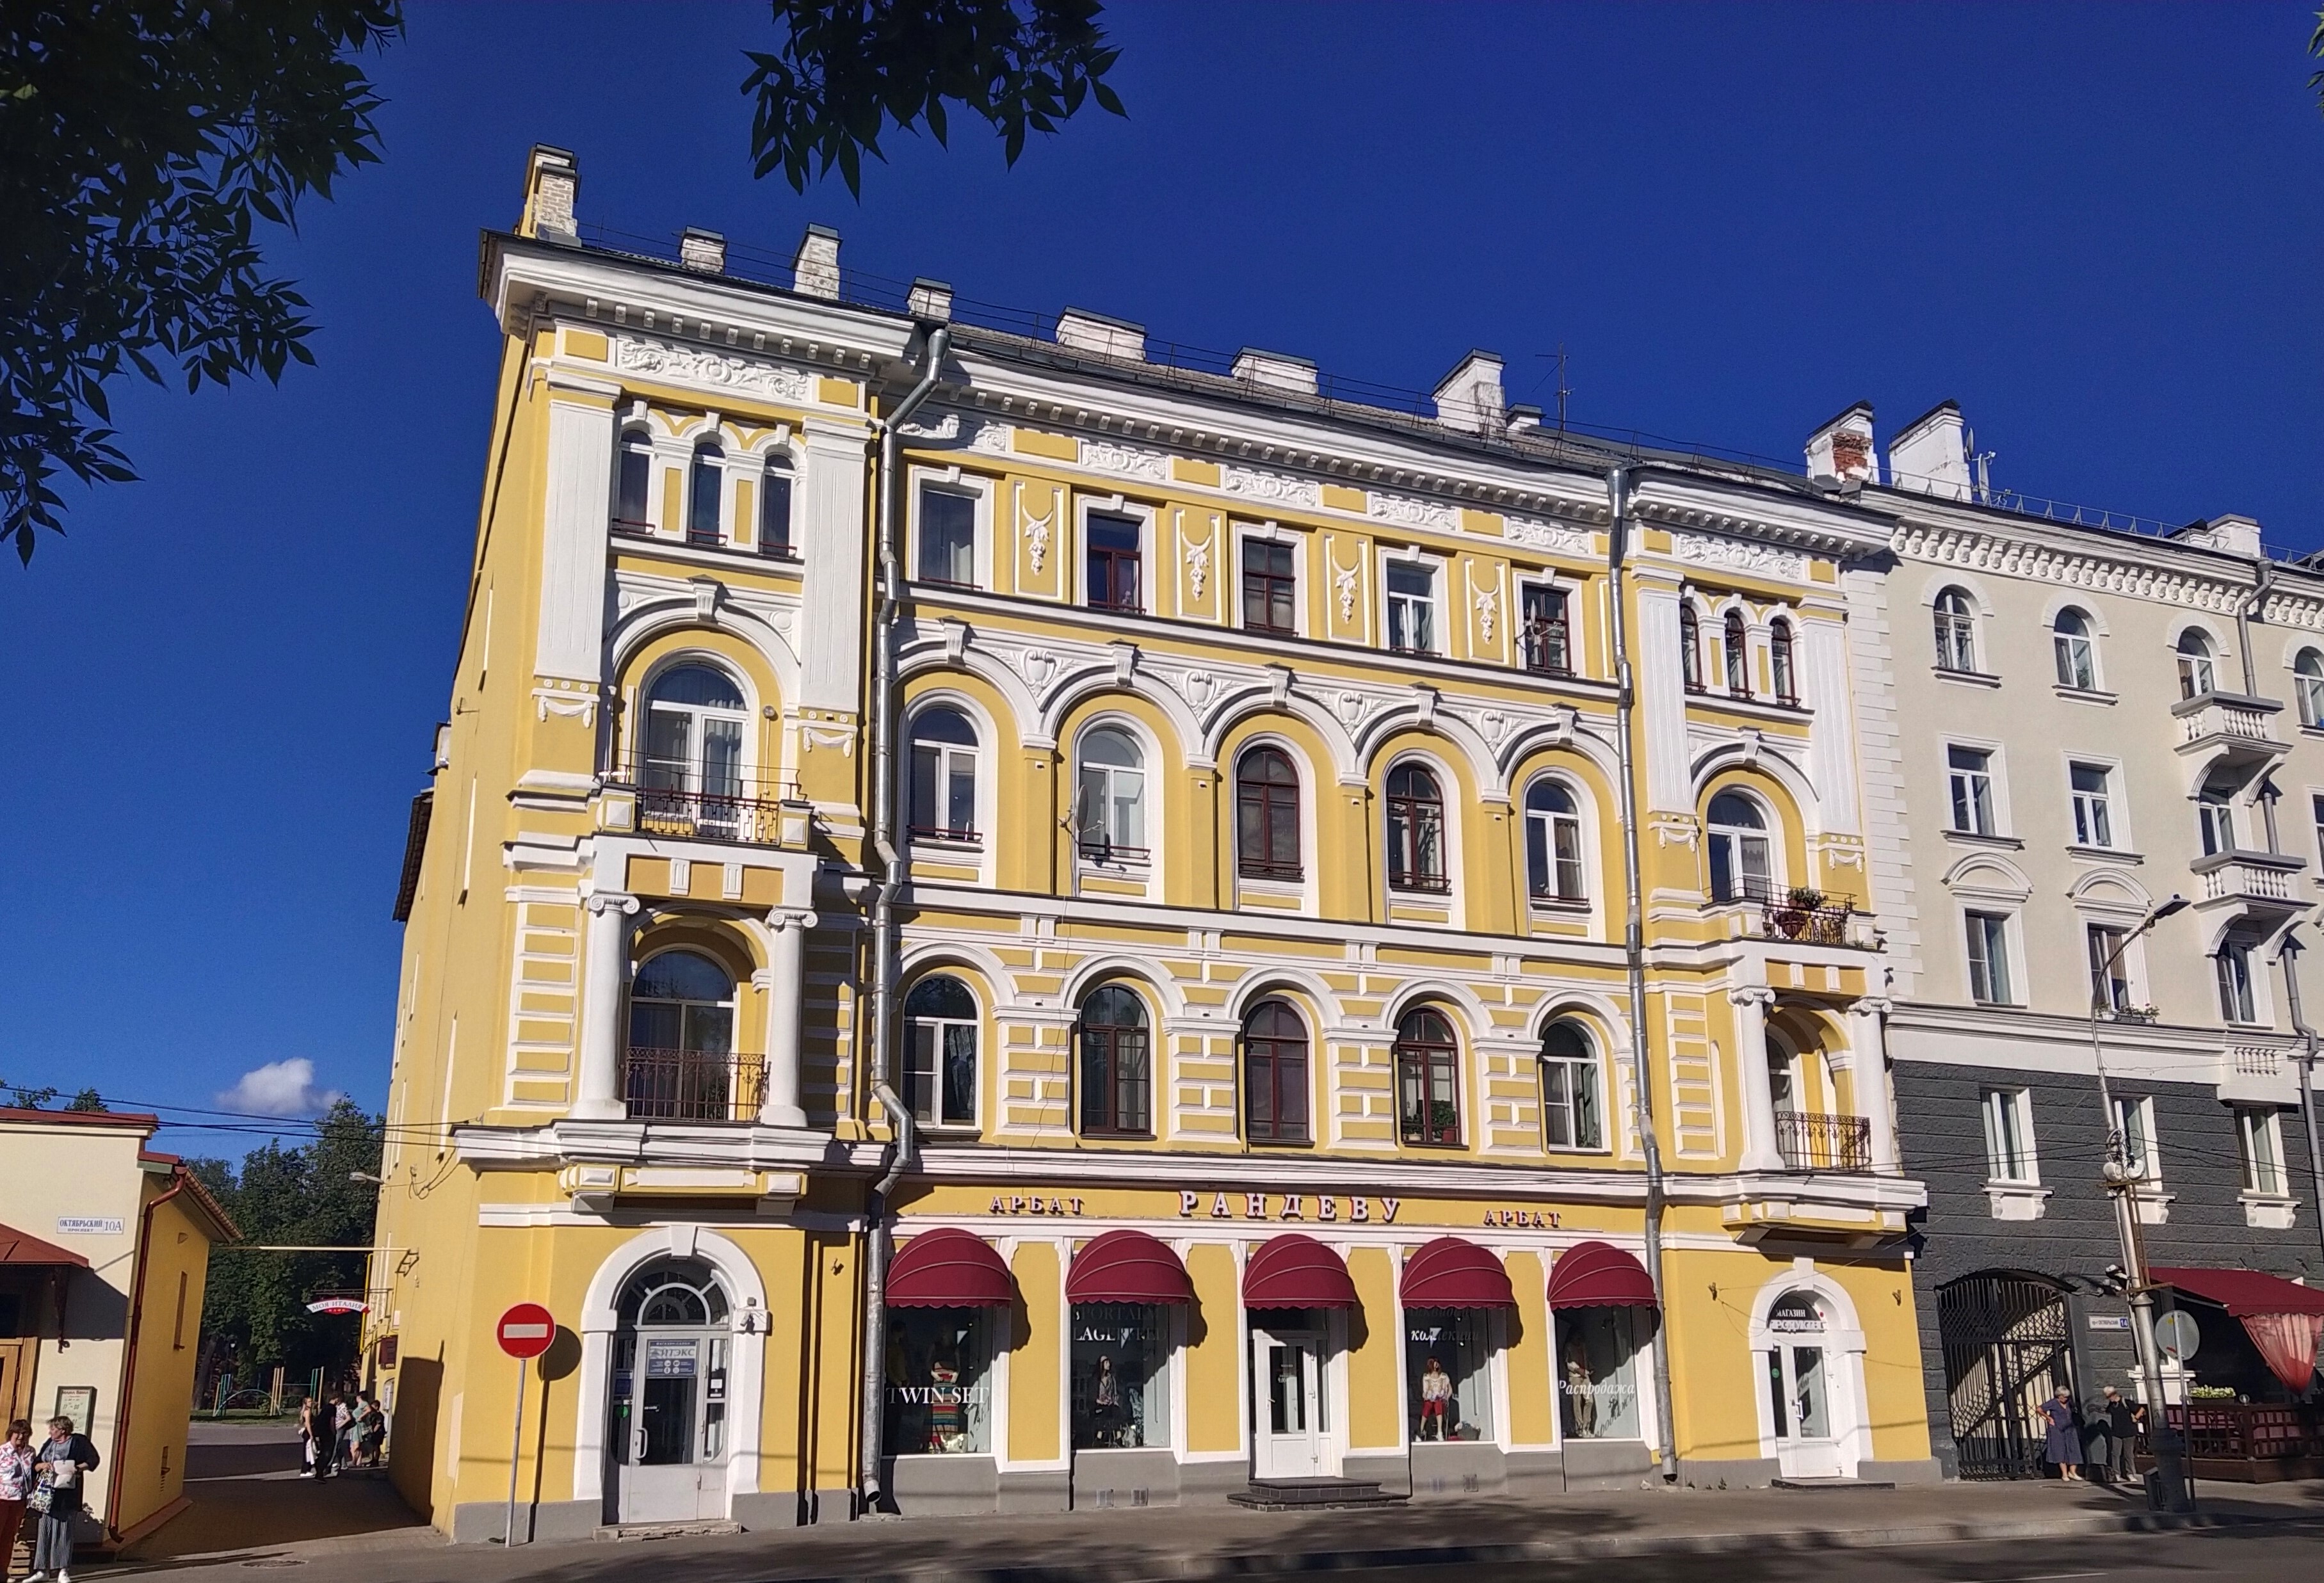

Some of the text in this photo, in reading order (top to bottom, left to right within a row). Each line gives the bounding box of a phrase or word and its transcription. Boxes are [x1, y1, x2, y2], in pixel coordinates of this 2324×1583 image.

[990, 1196, 1084, 1214] АРБАТ
[1180, 1191, 1400, 1221] РАНДЕВУ
[104, 1221, 122, 1231] 10А
[1484, 1210, 1561, 1226] АРБАТ
[312, 1301, 362, 1311] МОЯ ИТАЛИЯ
[1776, 1309, 1806, 1317] МАГАЗИН
[886, 1386, 990, 1404] TWIN SET
[1559, 1379, 1634, 1399] Распродажа
